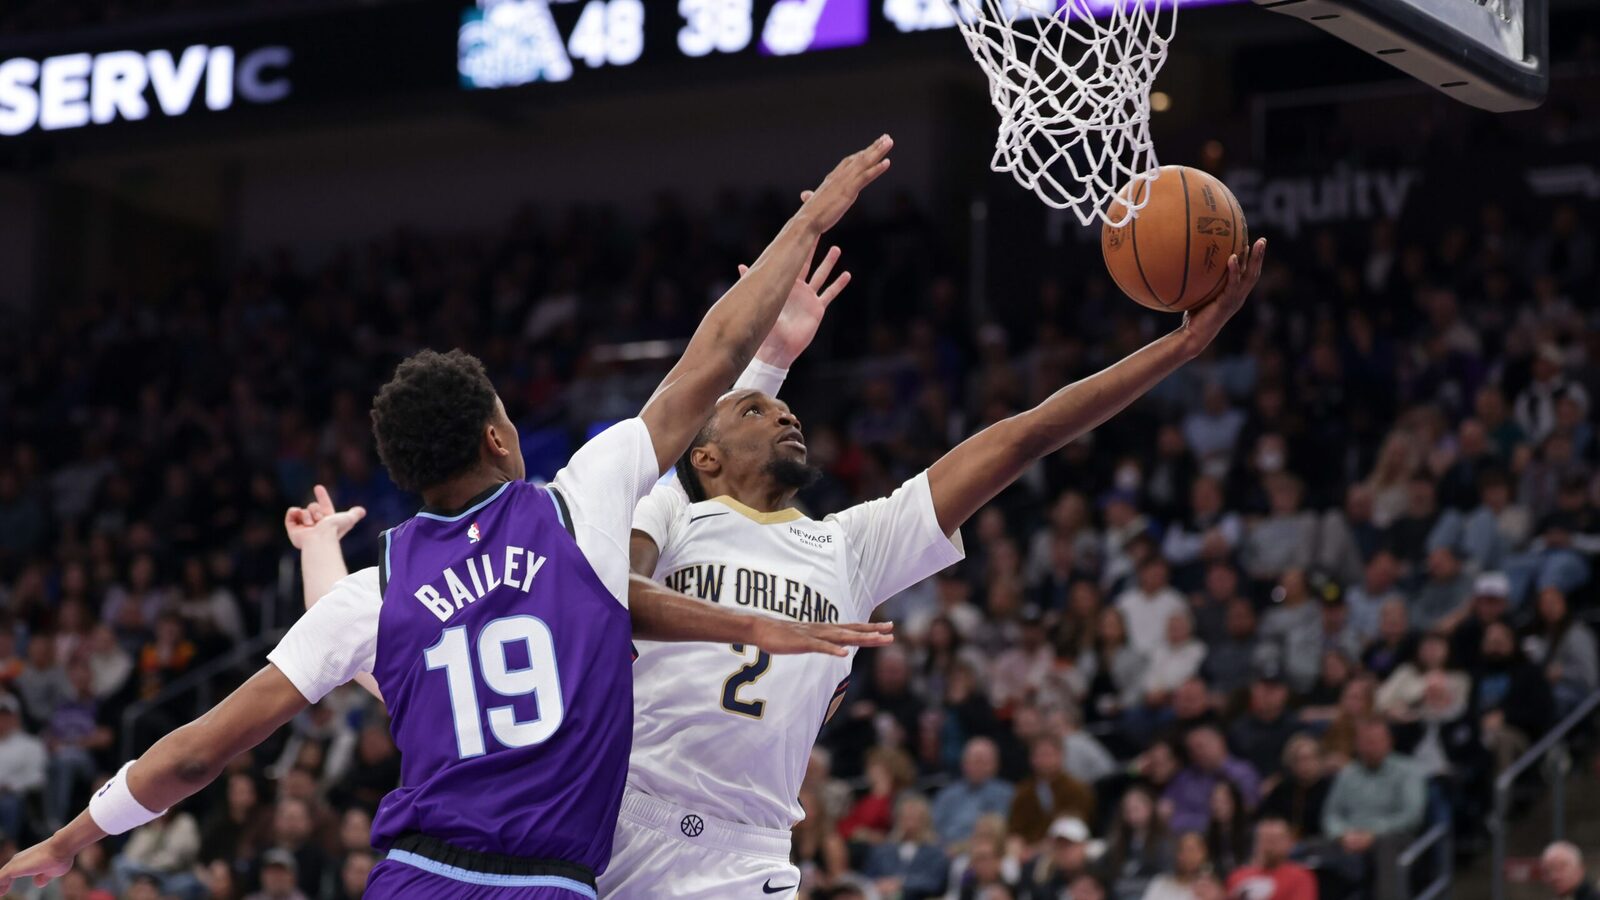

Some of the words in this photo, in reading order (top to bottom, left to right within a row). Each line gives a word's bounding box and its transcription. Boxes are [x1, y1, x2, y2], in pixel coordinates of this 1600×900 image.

[567, 0, 645, 67] 48
[677, 0, 752, 56] 38
[789, 525, 833, 543] NEWAGE
[799, 538, 823, 549] GRILLS
[413, 545, 548, 623] BAILEY
[424, 614, 565, 759] 19
[720, 643, 772, 720] 2
